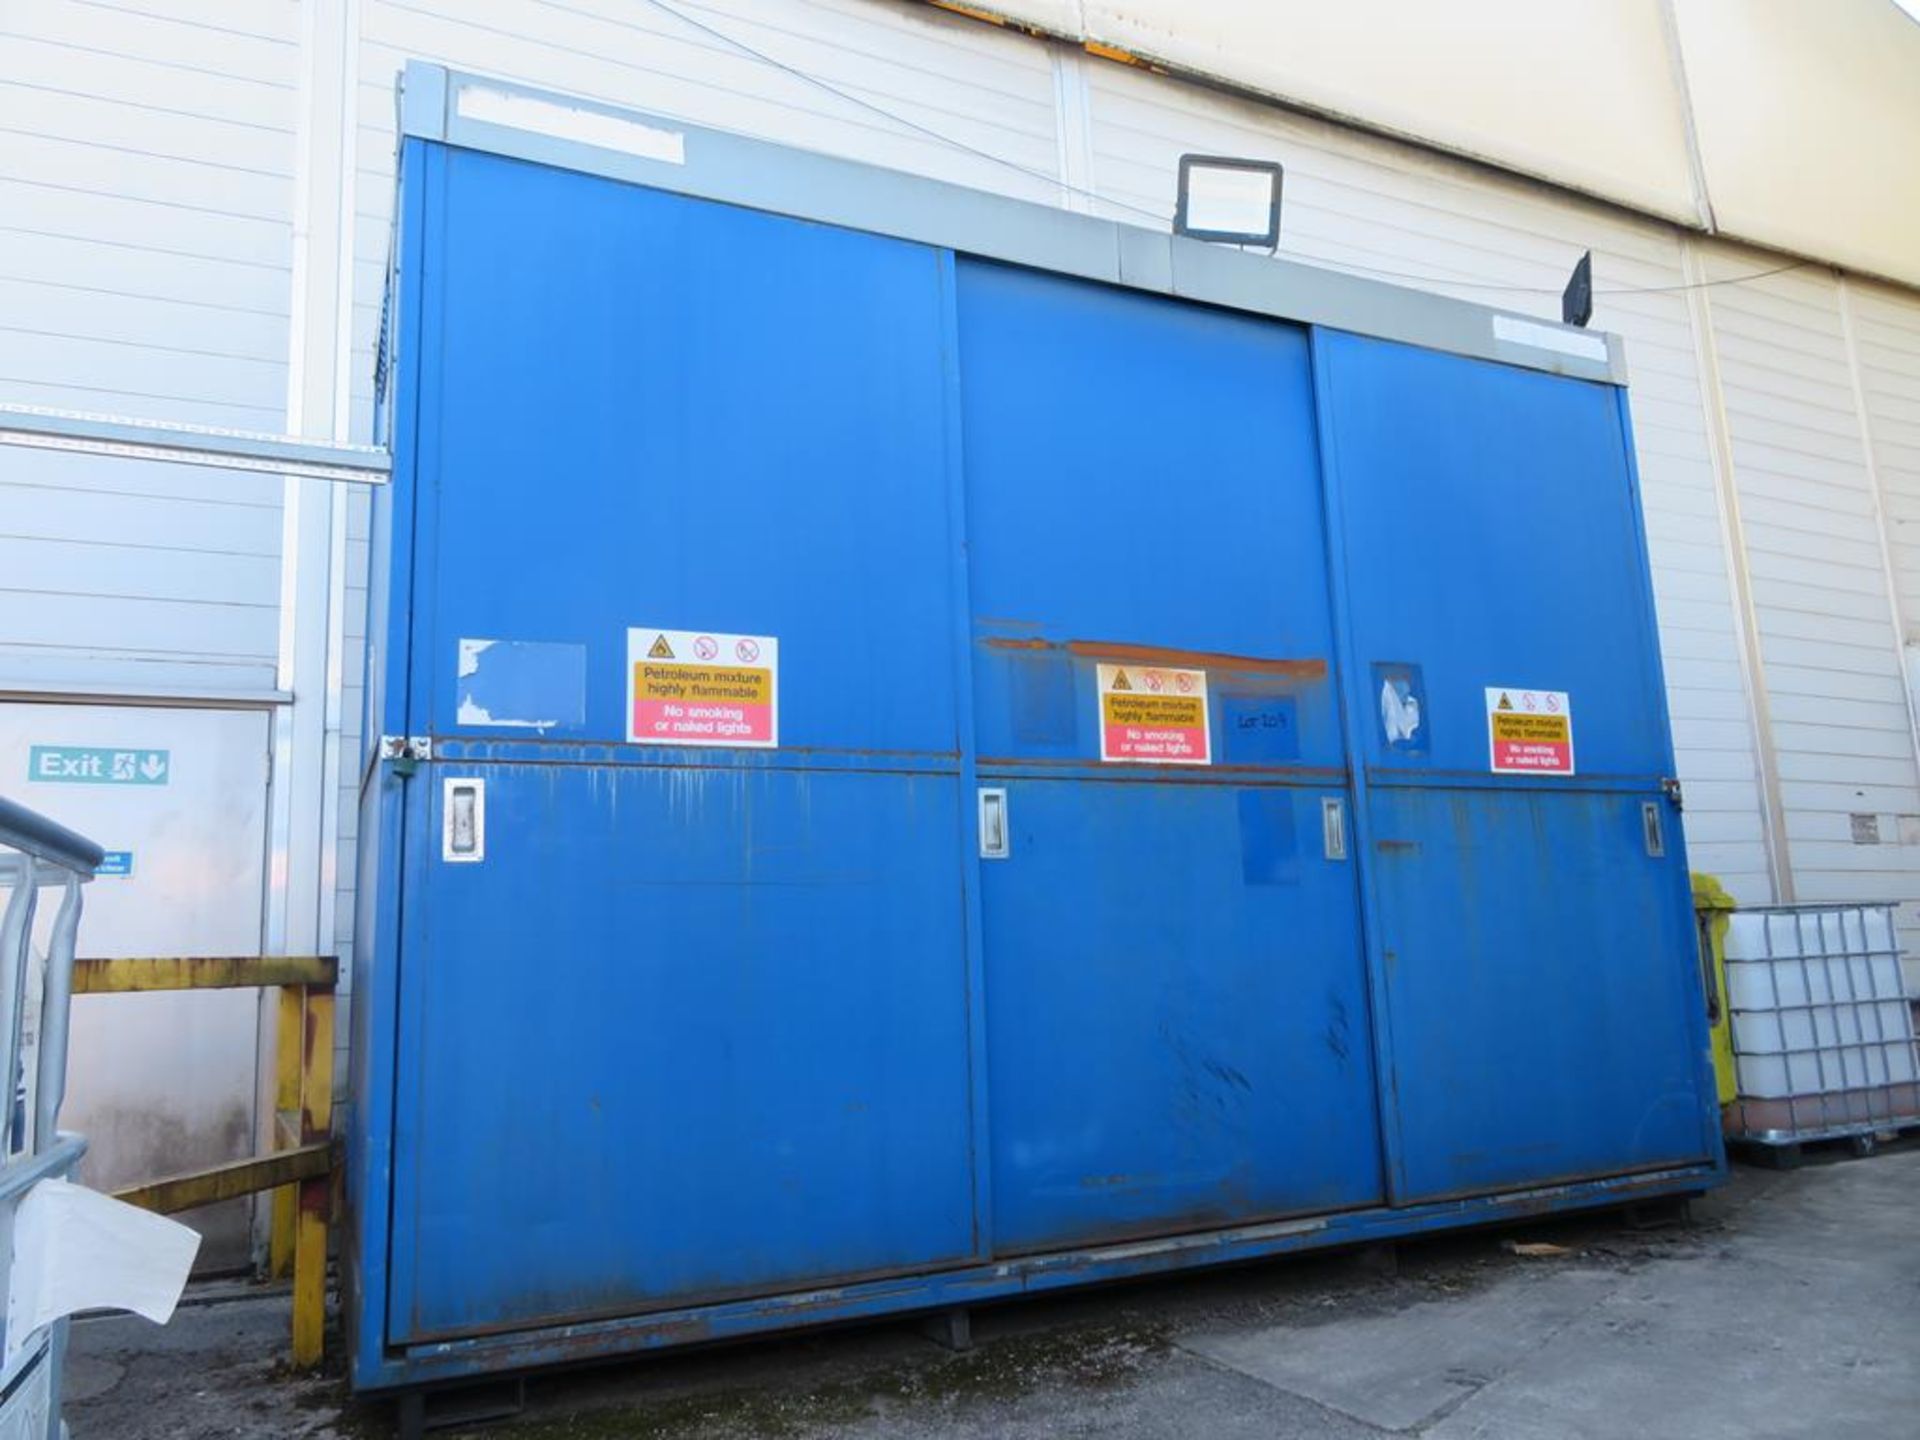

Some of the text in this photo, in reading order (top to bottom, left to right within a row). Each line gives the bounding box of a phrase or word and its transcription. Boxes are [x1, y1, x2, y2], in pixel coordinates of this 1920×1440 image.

[644, 667, 762, 684] Petroleum mixture
[647, 683, 759, 699] highly flammable
[1111, 698, 1197, 711] Petroleum mixture
[663, 704, 744, 721] No smoking
[1113, 711, 1195, 724] highly flammable
[654, 721, 752, 735] or naked lights
[1126, 728, 1185, 743] No smoking
[1120, 742, 1193, 755] or naked lights
[38, 752, 104, 777] Exit
